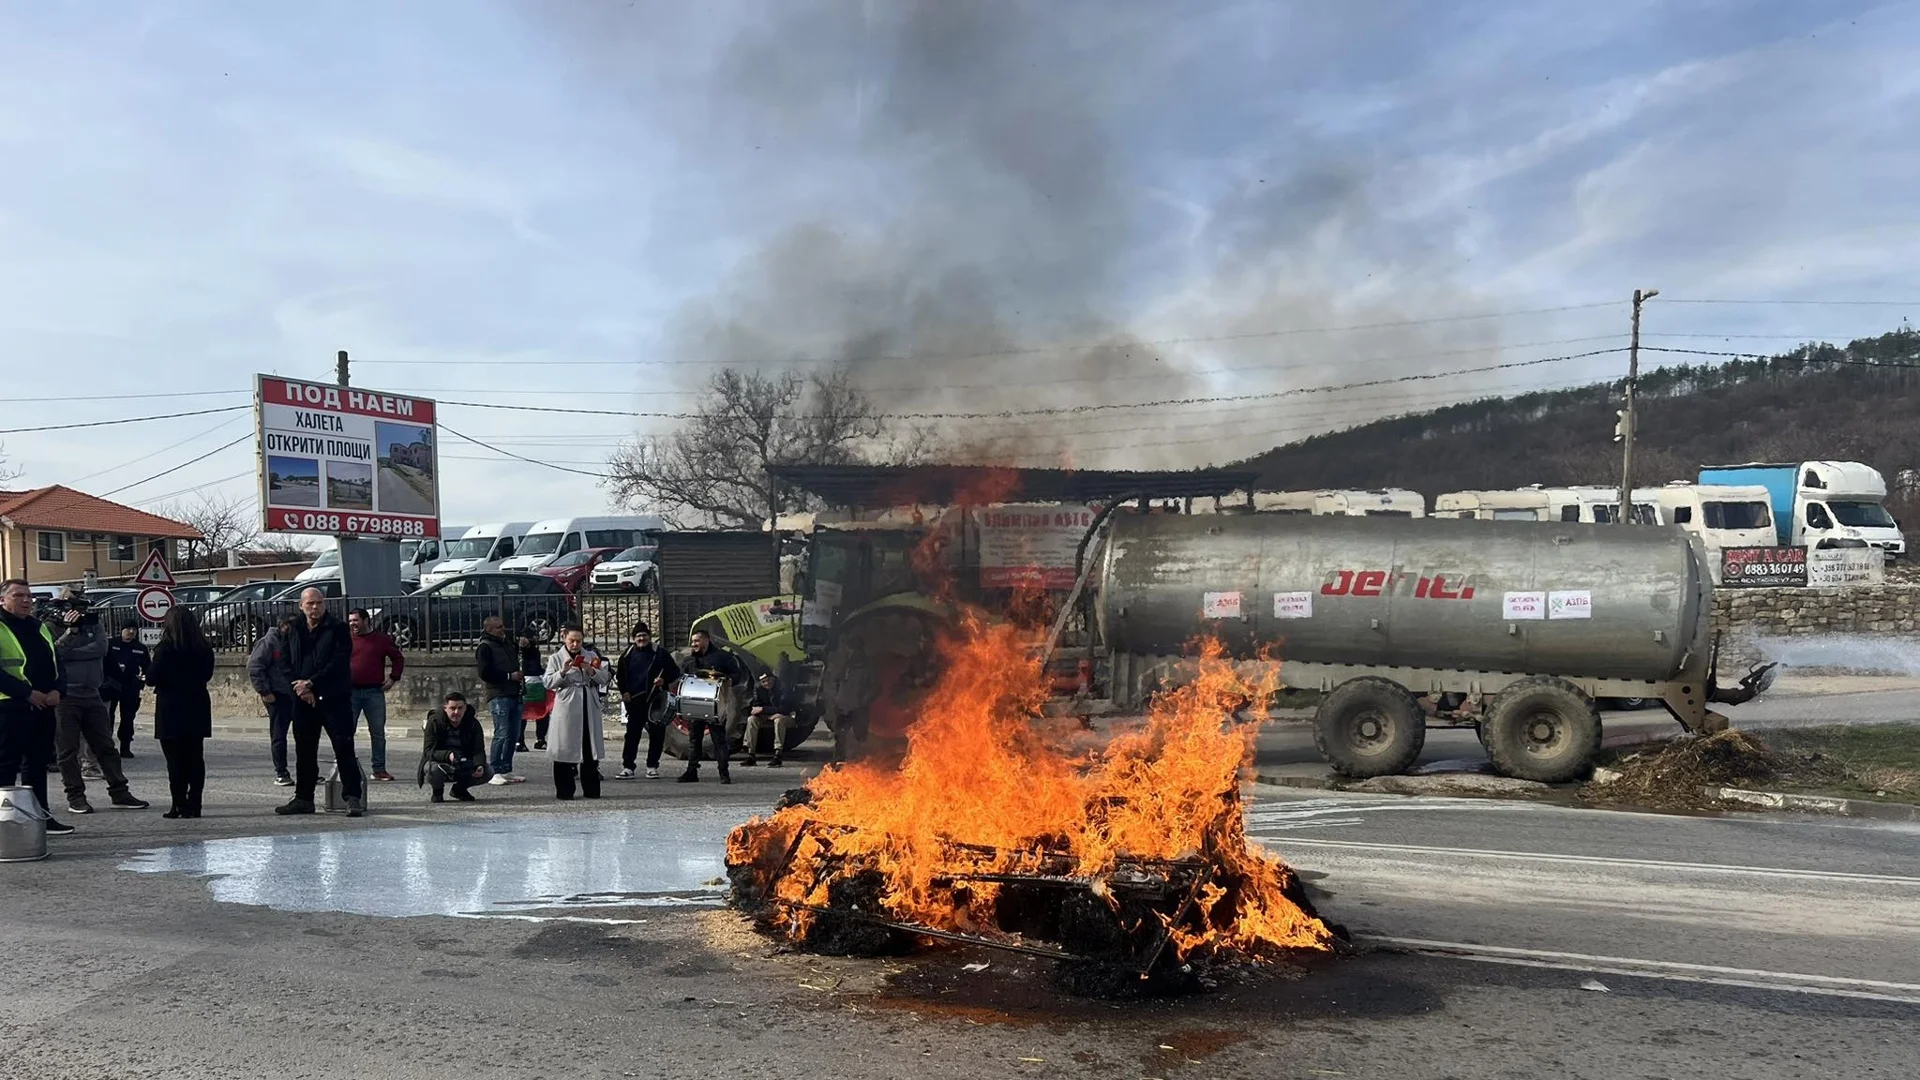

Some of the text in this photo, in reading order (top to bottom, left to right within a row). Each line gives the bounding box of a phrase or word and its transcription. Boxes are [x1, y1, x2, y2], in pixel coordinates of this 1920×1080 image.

[285, 382, 414, 416] ПОД НАЕМ
[295, 411, 344, 432] ХАЛЕТА
[267, 433, 371, 460] ОТКРИТИ ПЛОЩИ
[303, 513, 425, 535] 088 6798888
[1726, 549, 1804, 563] RENT A CAR
